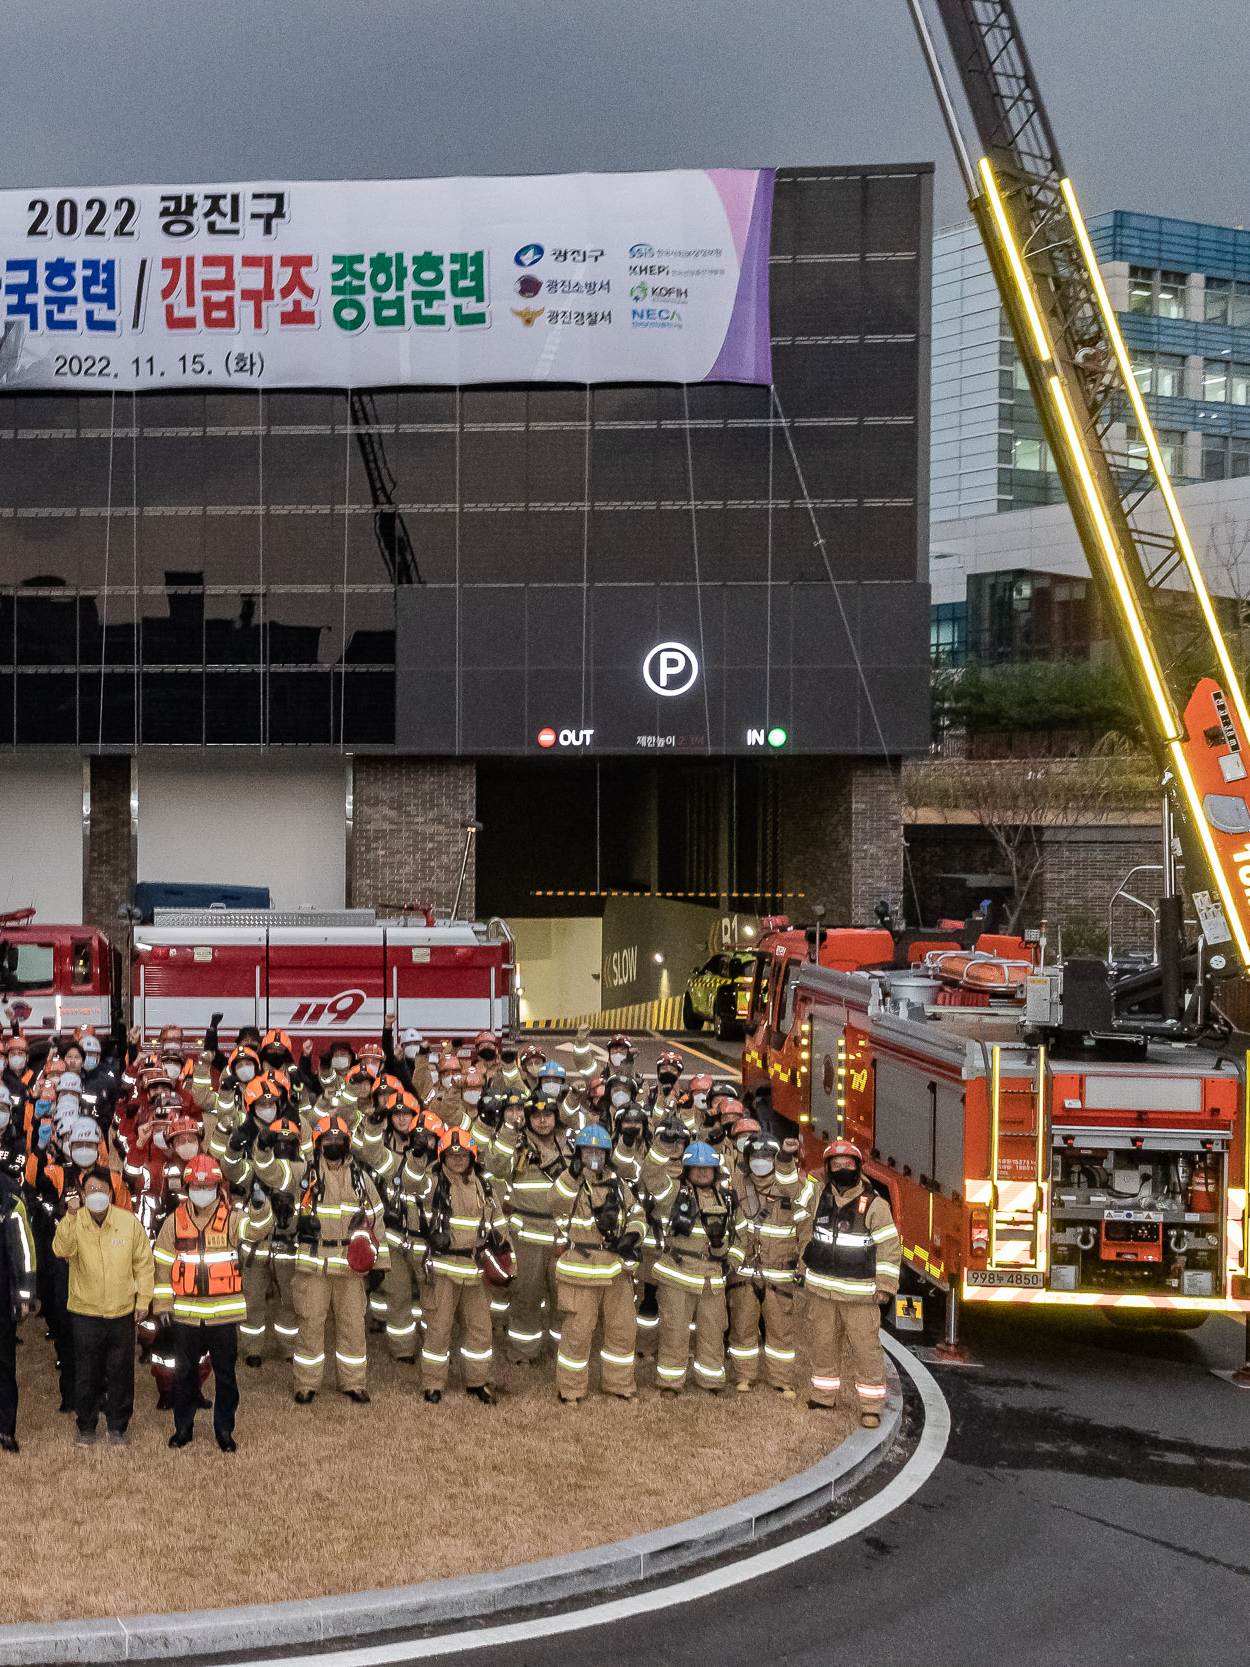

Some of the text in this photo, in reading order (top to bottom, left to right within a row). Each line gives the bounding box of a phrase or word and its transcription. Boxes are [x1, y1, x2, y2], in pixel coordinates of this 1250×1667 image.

[27, 191, 287, 237] 2022 광진구
[160, 254, 317, 330] 긴급구조
[331, 249, 486, 331] 종합훈련
[546, 279, 611, 295] 광진소방서
[546, 309, 612, 326] 광진경찰서
[631, 308, 682, 321] NECA
[54, 351, 264, 378] 2022. 11. 15. (화)
[558, 728, 594, 746] OUT
[636, 735, 676, 747] 제한높이
[746, 728, 765, 746] IN
[612, 945, 639, 987] SLOW
[288, 988, 366, 1025] 119
[1007, 1273, 1038, 1286] 4850
